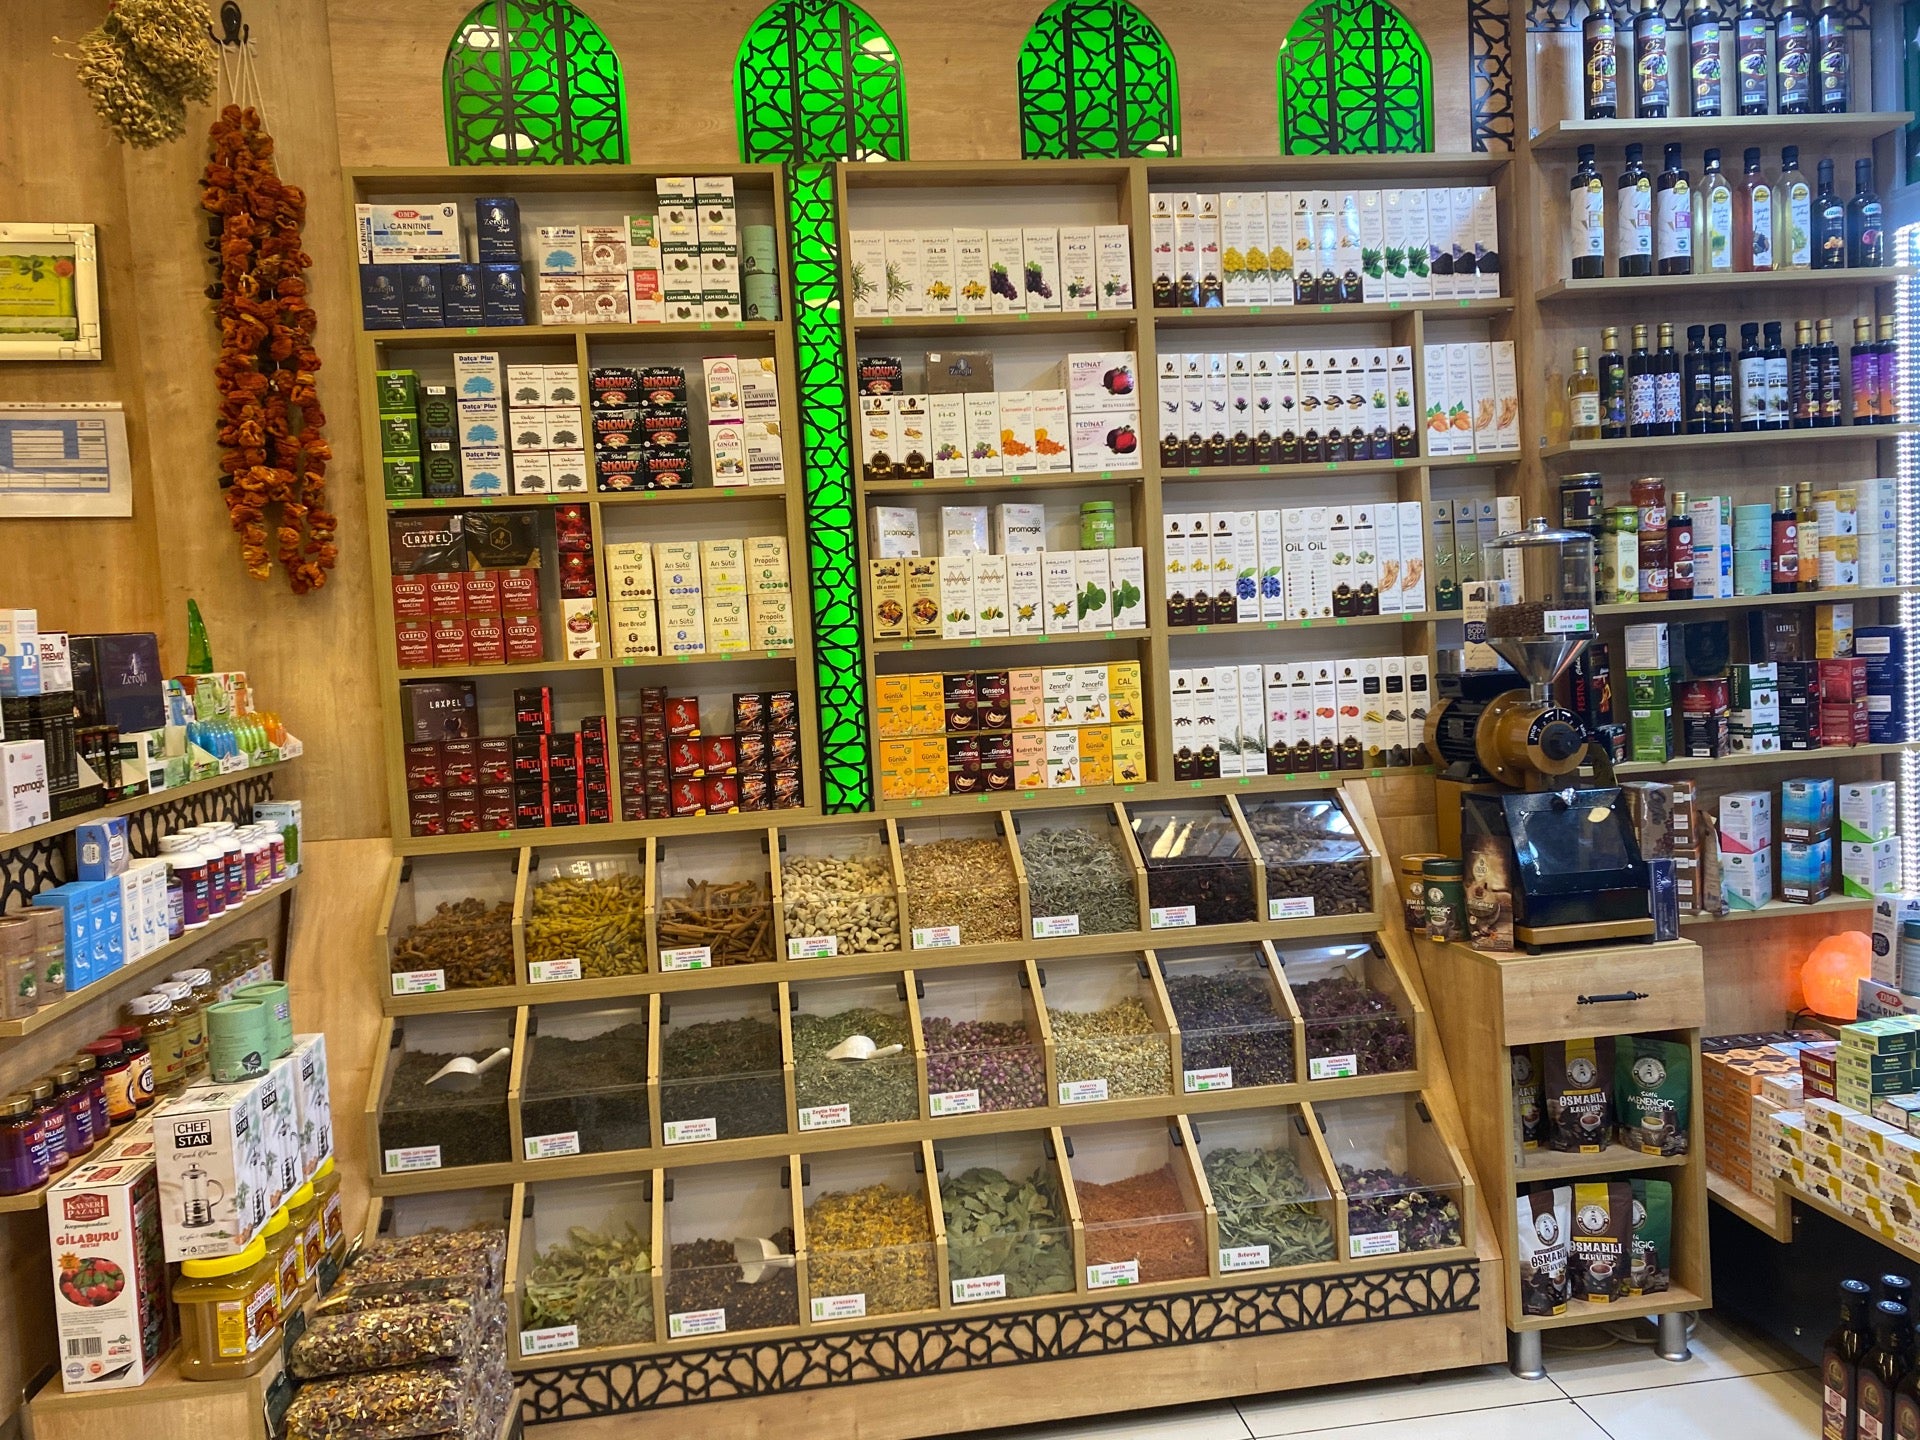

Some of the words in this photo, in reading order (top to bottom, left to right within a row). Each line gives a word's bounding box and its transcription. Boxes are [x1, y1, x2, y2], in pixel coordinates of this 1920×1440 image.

[1008, 525, 1040, 534] promagic
[408, 534, 447, 543] LAXPEL
[42, 653, 64, 661] PREMIX
[430, 700, 461, 708] LAXPEL
[13, 780, 45, 798] promagic
[1880, 993, 1898, 1005] DMP
[1559, 1092, 1607, 1106] OSMANLI
[1627, 1095, 1674, 1110] MENENGİÇ
[177, 1122, 207, 1134] CHEF
[178, 1135, 208, 1146] STAR
[56, 1231, 119, 1245] GİLABURU
